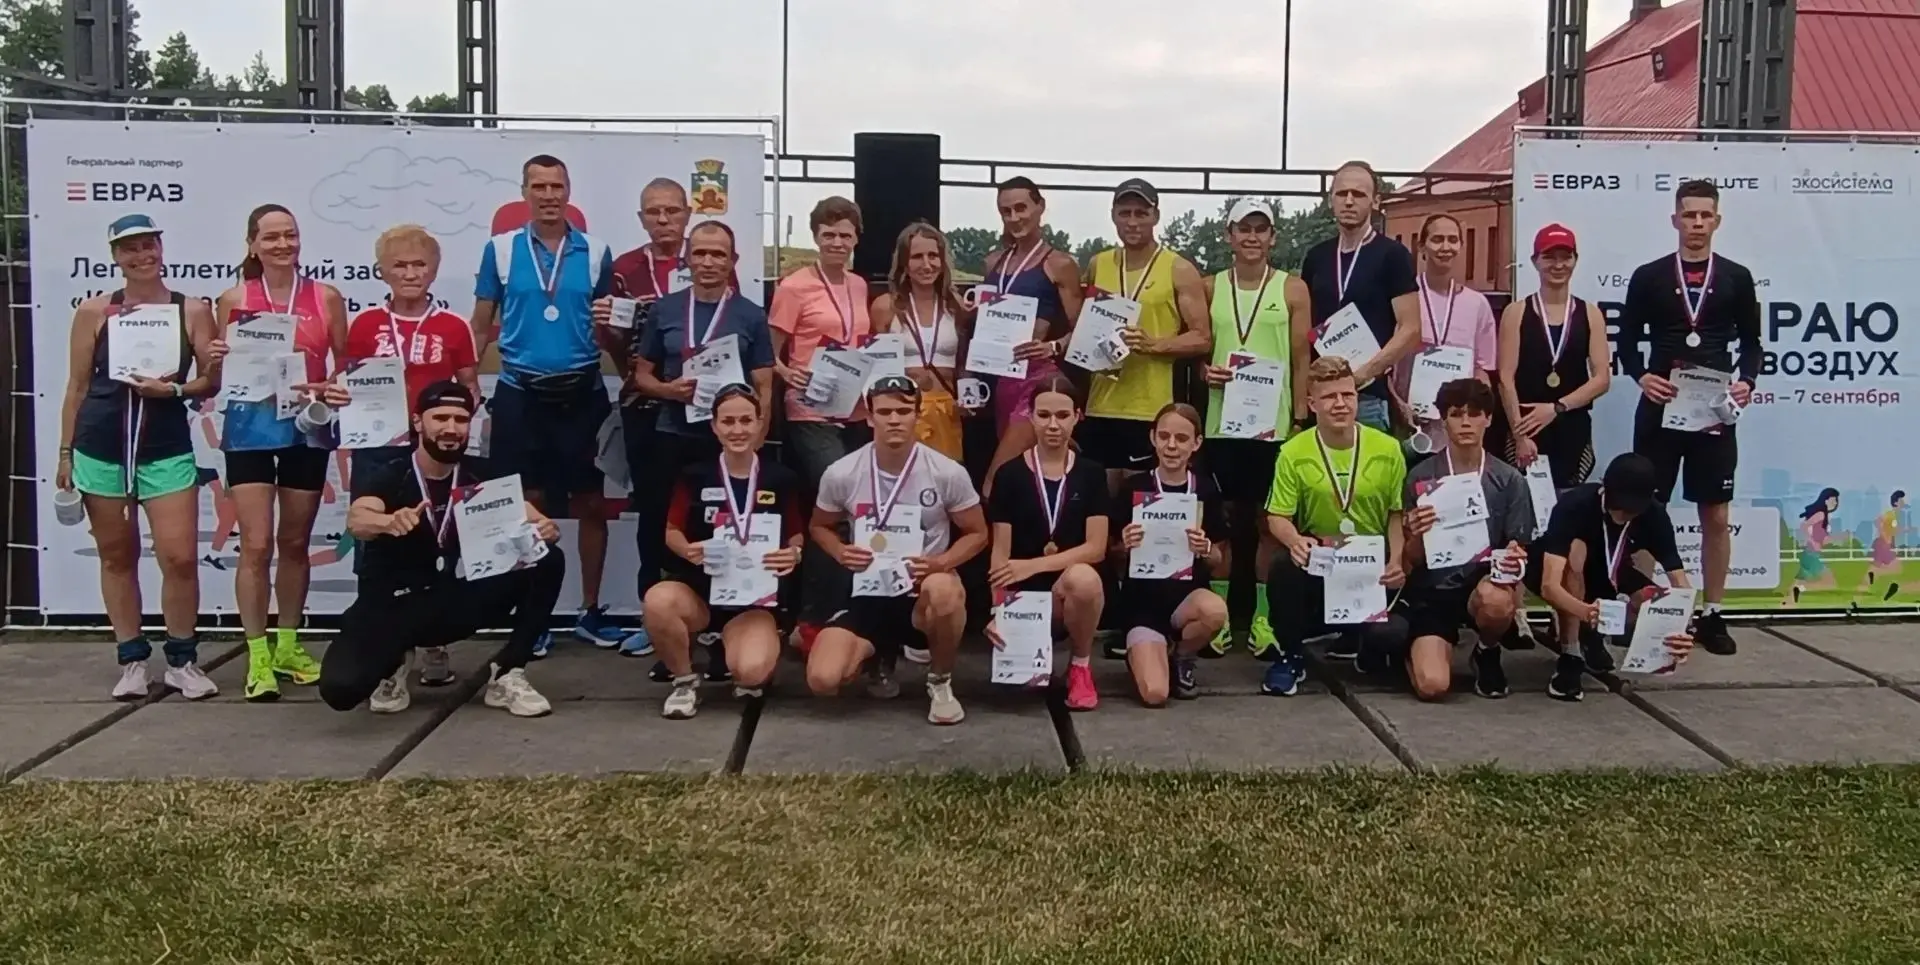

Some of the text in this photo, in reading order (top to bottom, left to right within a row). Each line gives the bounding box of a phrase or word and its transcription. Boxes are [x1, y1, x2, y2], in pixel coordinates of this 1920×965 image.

[66, 155, 183, 168] Генеральный партнер
[1552, 174, 1620, 190] ЕВРАЗ
[92, 182, 184, 202] ЕВРАЗ
[119, 320, 170, 328] ГРАМОТА
[1323, 322, 1359, 350] ГРАМОТА
[1421, 358, 1462, 372] ГРАМОТА
[1760, 351, 1900, 381] ВОЗДУХ
[346, 376, 396, 388] ГРАМОТА
[1235, 371, 1275, 387] ГРАМОТА
[1794, 390, 1805, 404] 7
[1811, 389, 1900, 406] сентября
[1142, 510, 1188, 521] ГРАМОТА
